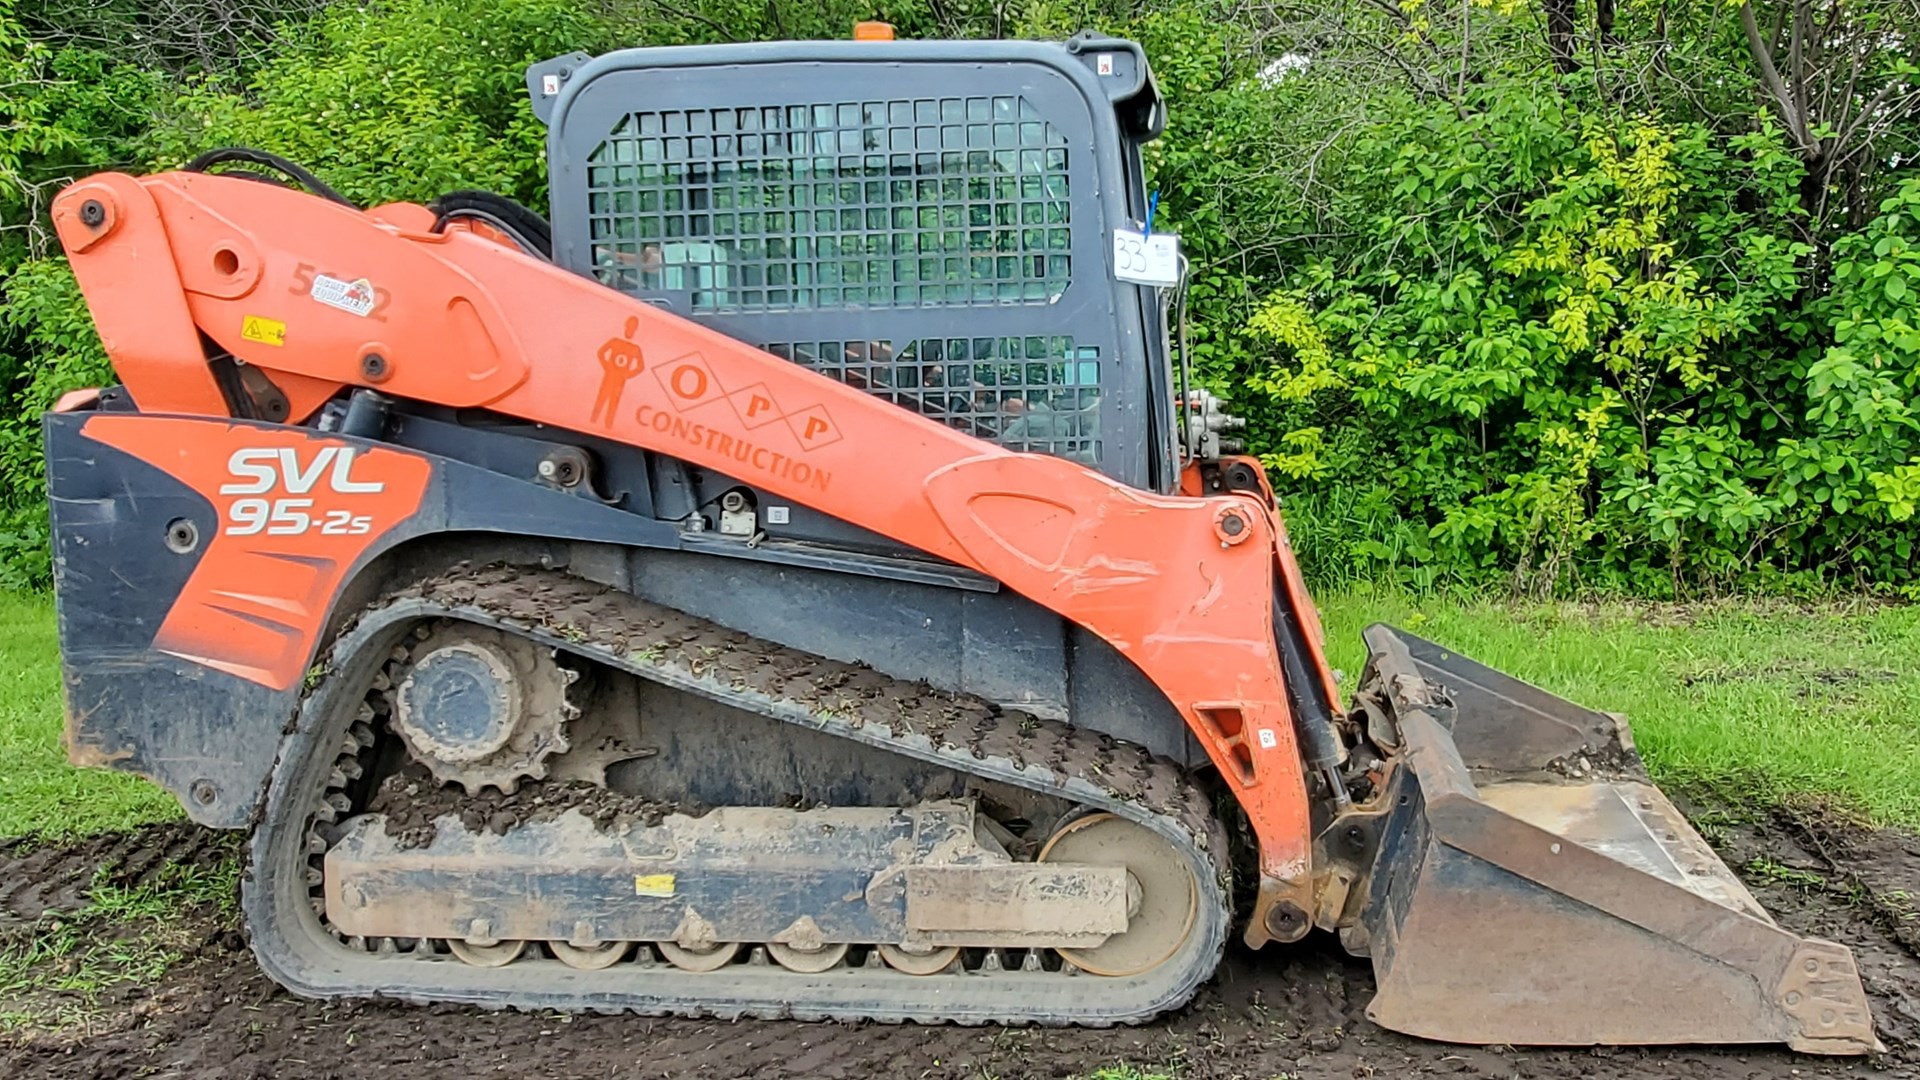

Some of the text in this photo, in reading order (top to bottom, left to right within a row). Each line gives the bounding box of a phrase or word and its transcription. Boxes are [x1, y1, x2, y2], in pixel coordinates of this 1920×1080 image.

[1116, 237, 1147, 273] 33
[219, 446, 384, 495] SVL
[635, 404, 833, 492] CONSTRUCTION
